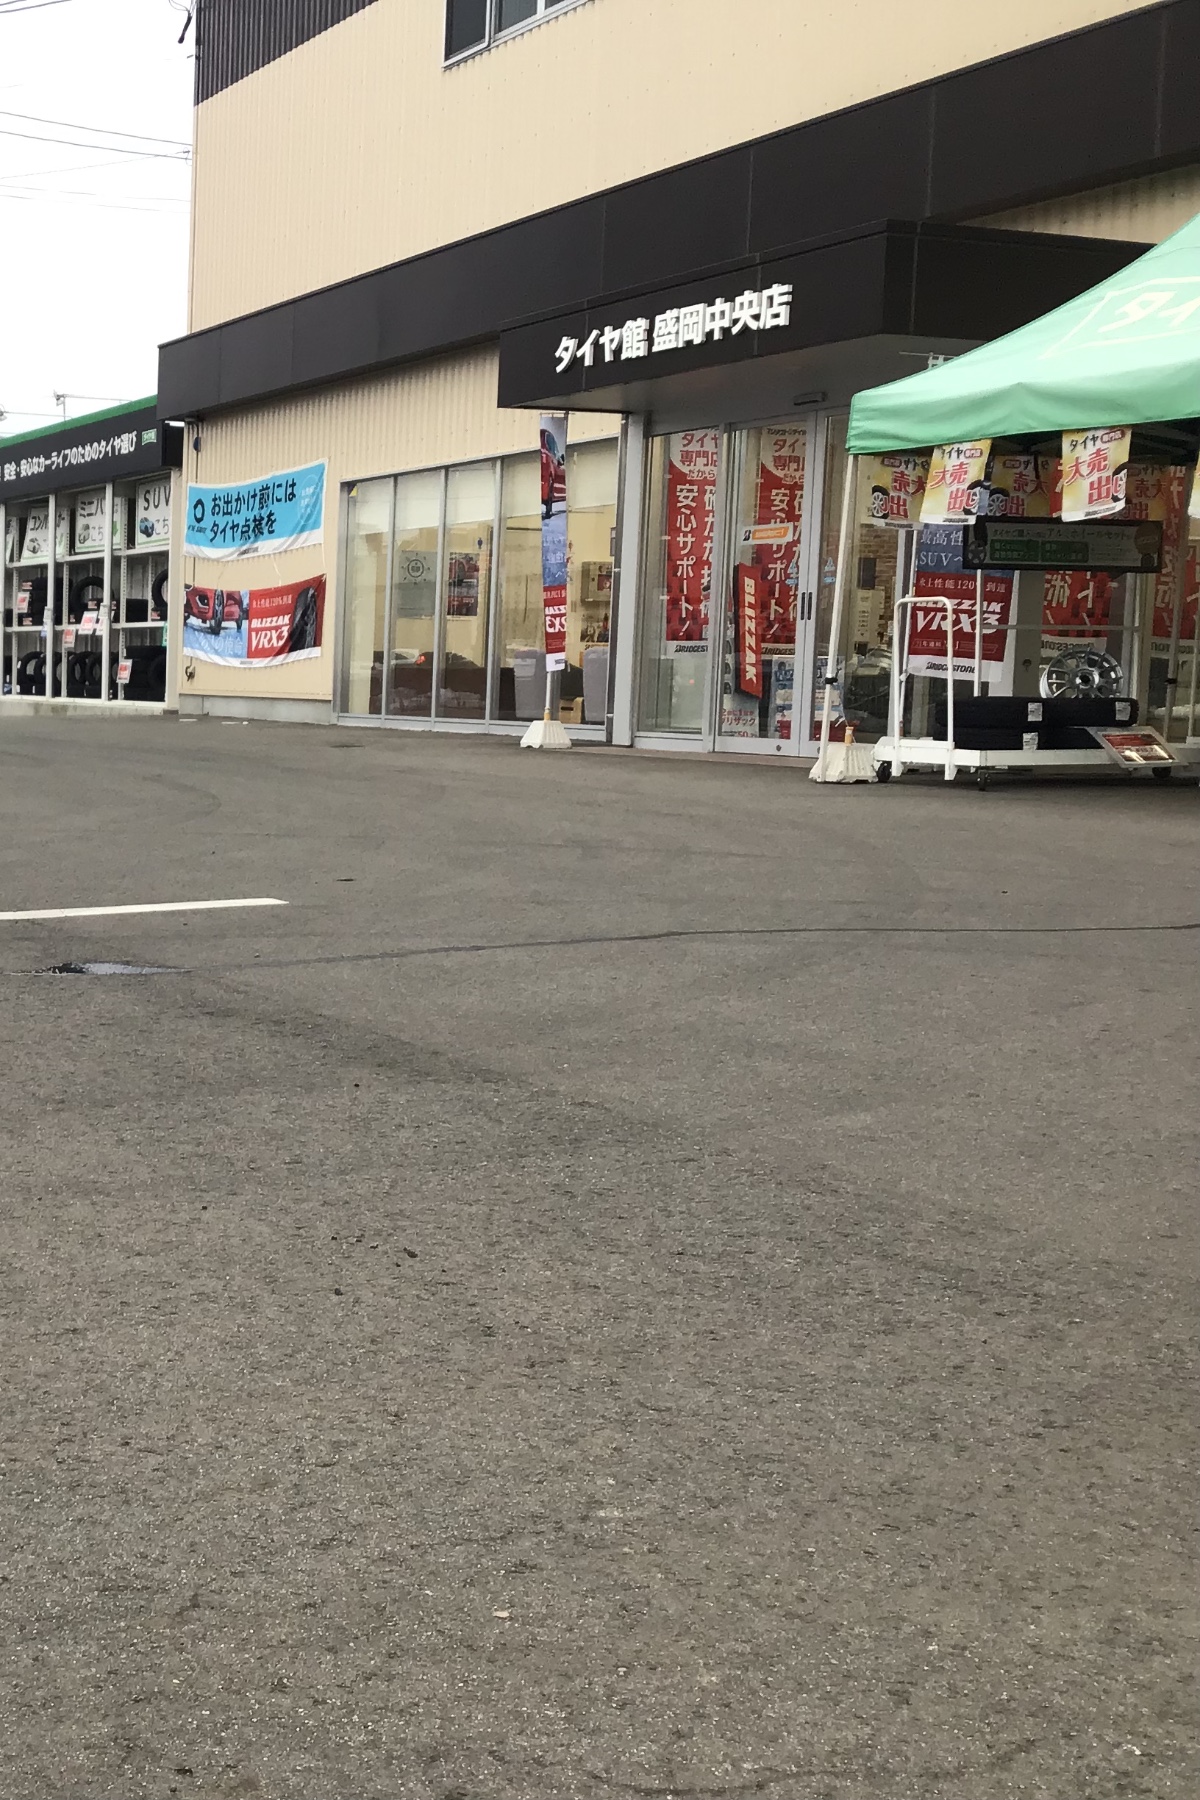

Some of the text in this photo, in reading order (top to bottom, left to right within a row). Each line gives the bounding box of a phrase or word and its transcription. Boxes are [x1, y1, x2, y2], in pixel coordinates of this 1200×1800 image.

[555, 283, 792, 373] タイヤ館 盛岡中央店
[143, 486, 171, 512] SUV
[210, 478, 297, 518] お出かけ前には
[209, 510, 277, 543] タイヤ点検を
[250, 613, 291, 629] BLIZZAK
[744, 576, 757, 684] BLIZZAK
[916, 610, 1002, 635] VRX3
[250, 625, 290, 652] VRX3
